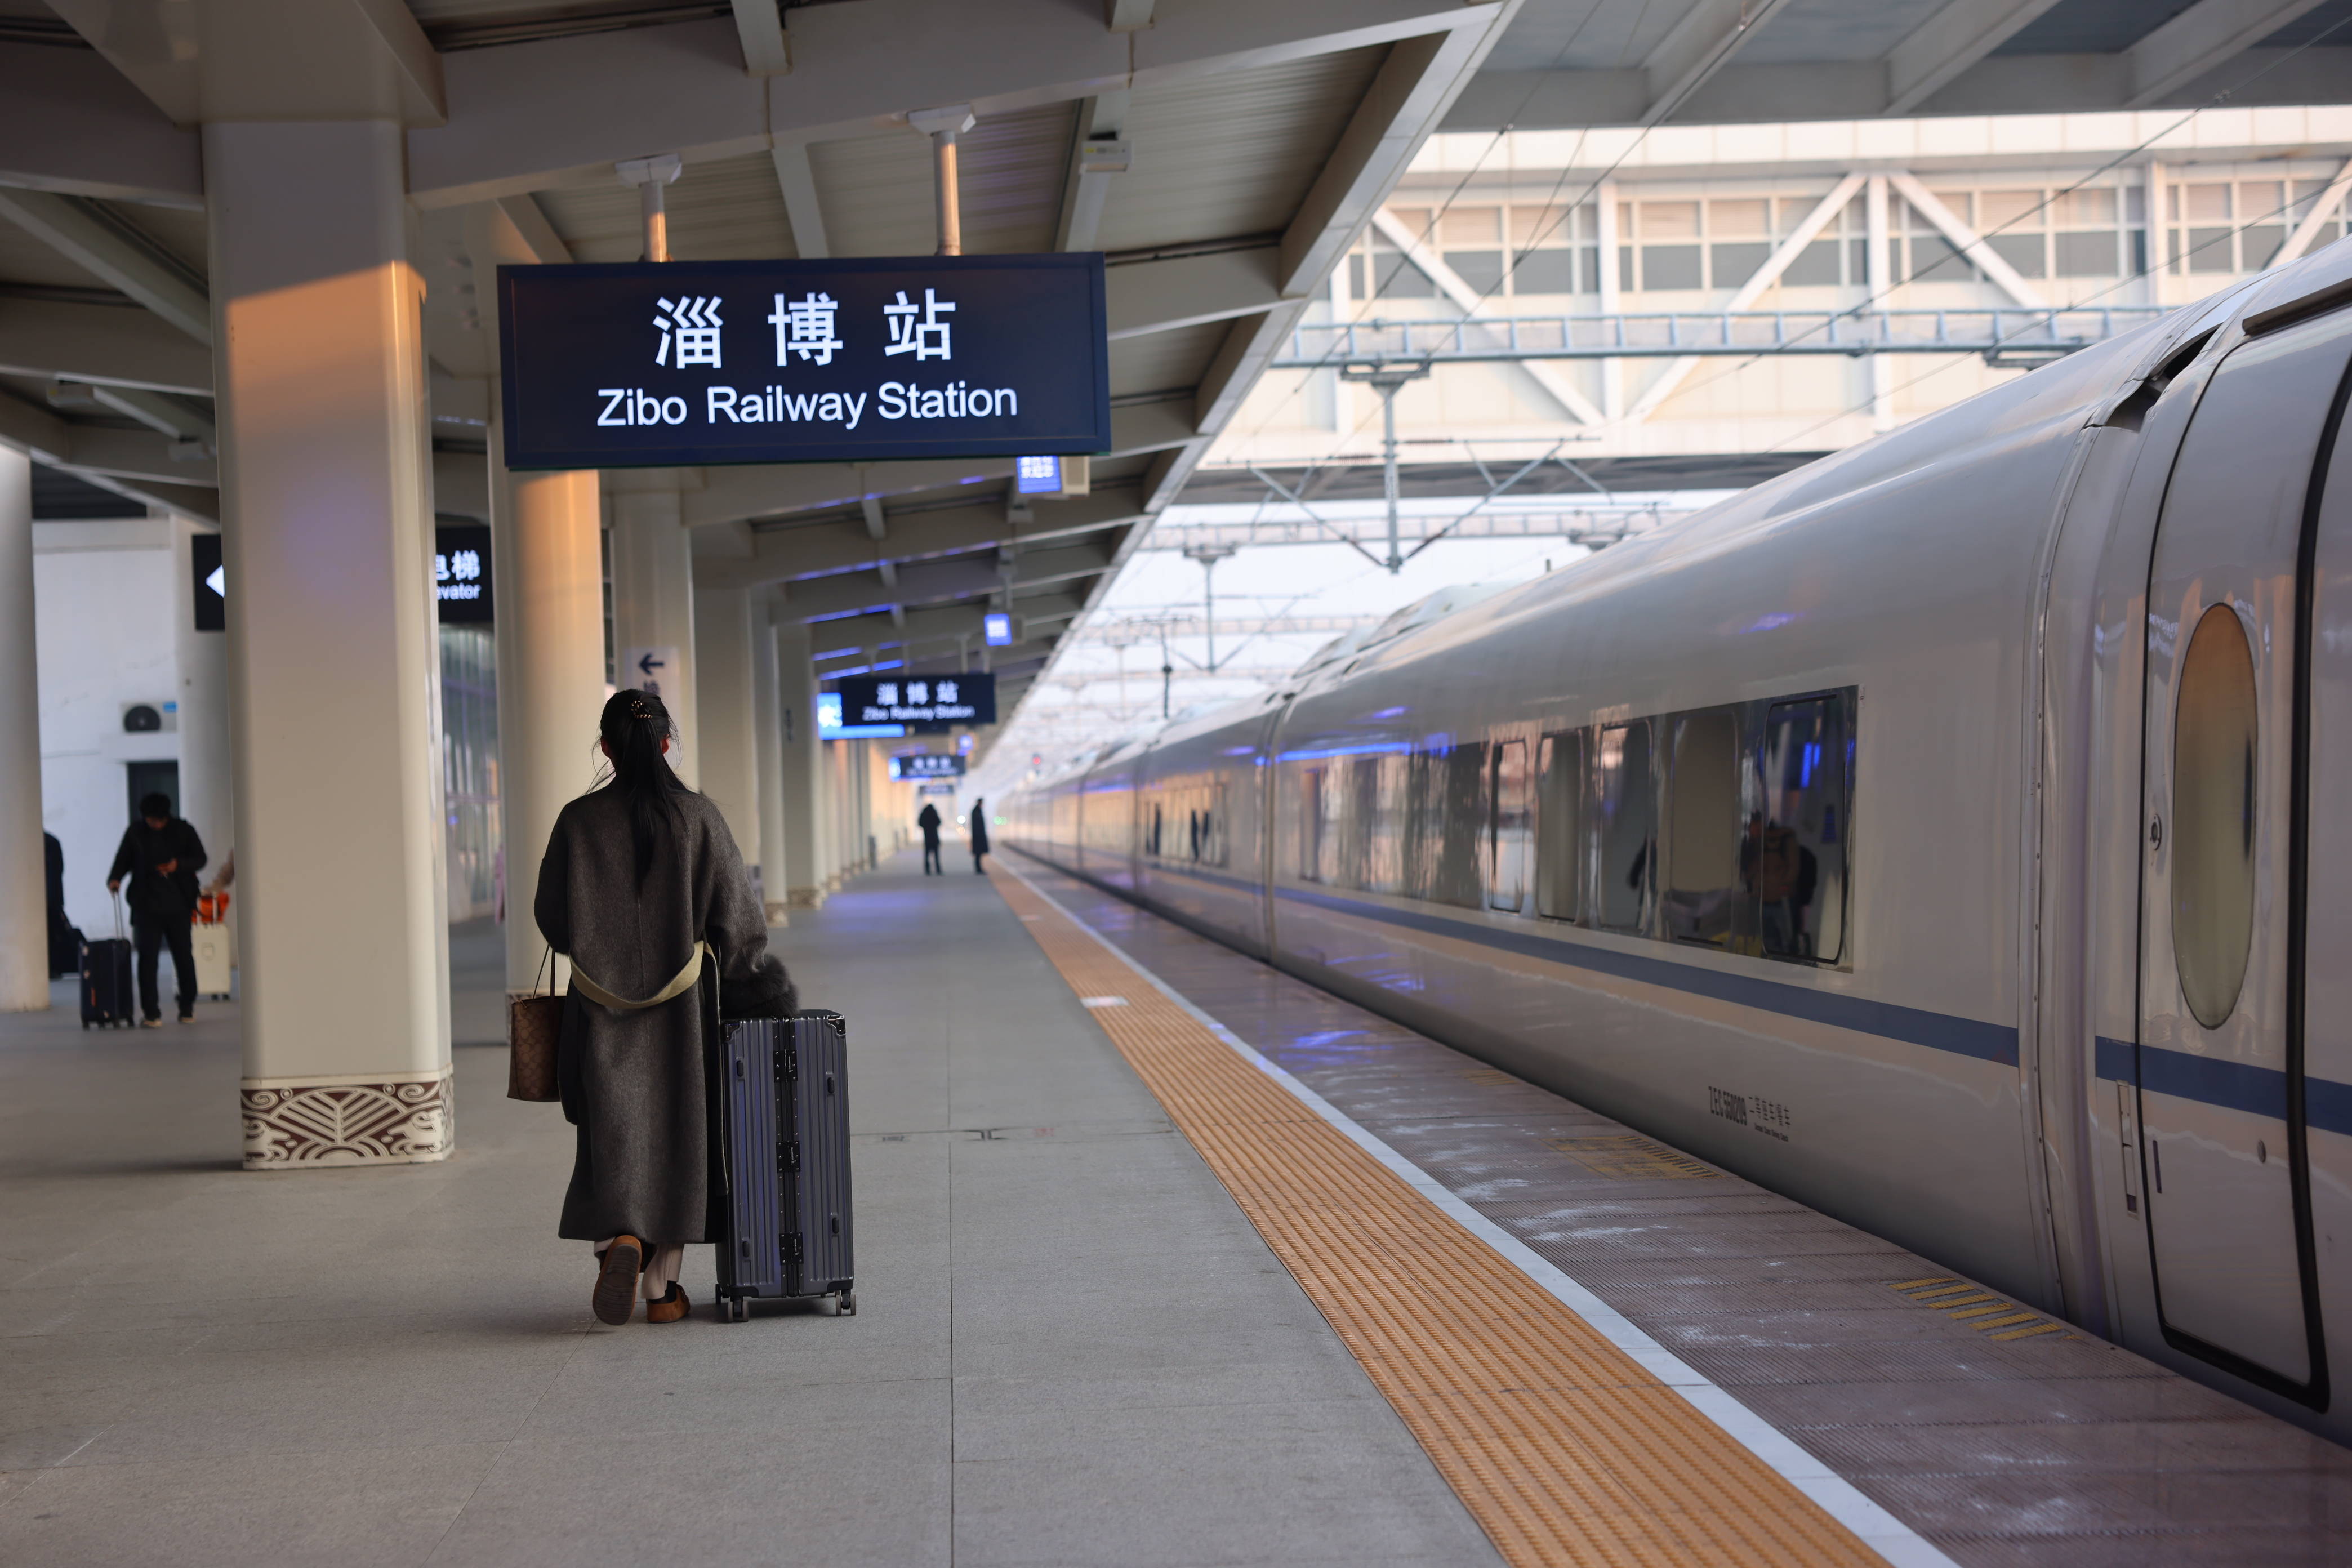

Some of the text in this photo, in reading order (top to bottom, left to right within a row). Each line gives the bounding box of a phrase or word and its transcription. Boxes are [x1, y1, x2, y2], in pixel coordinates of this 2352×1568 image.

[652, 288, 956, 369] 淄博站
[597, 381, 1017, 430] Zibo Railway Station
